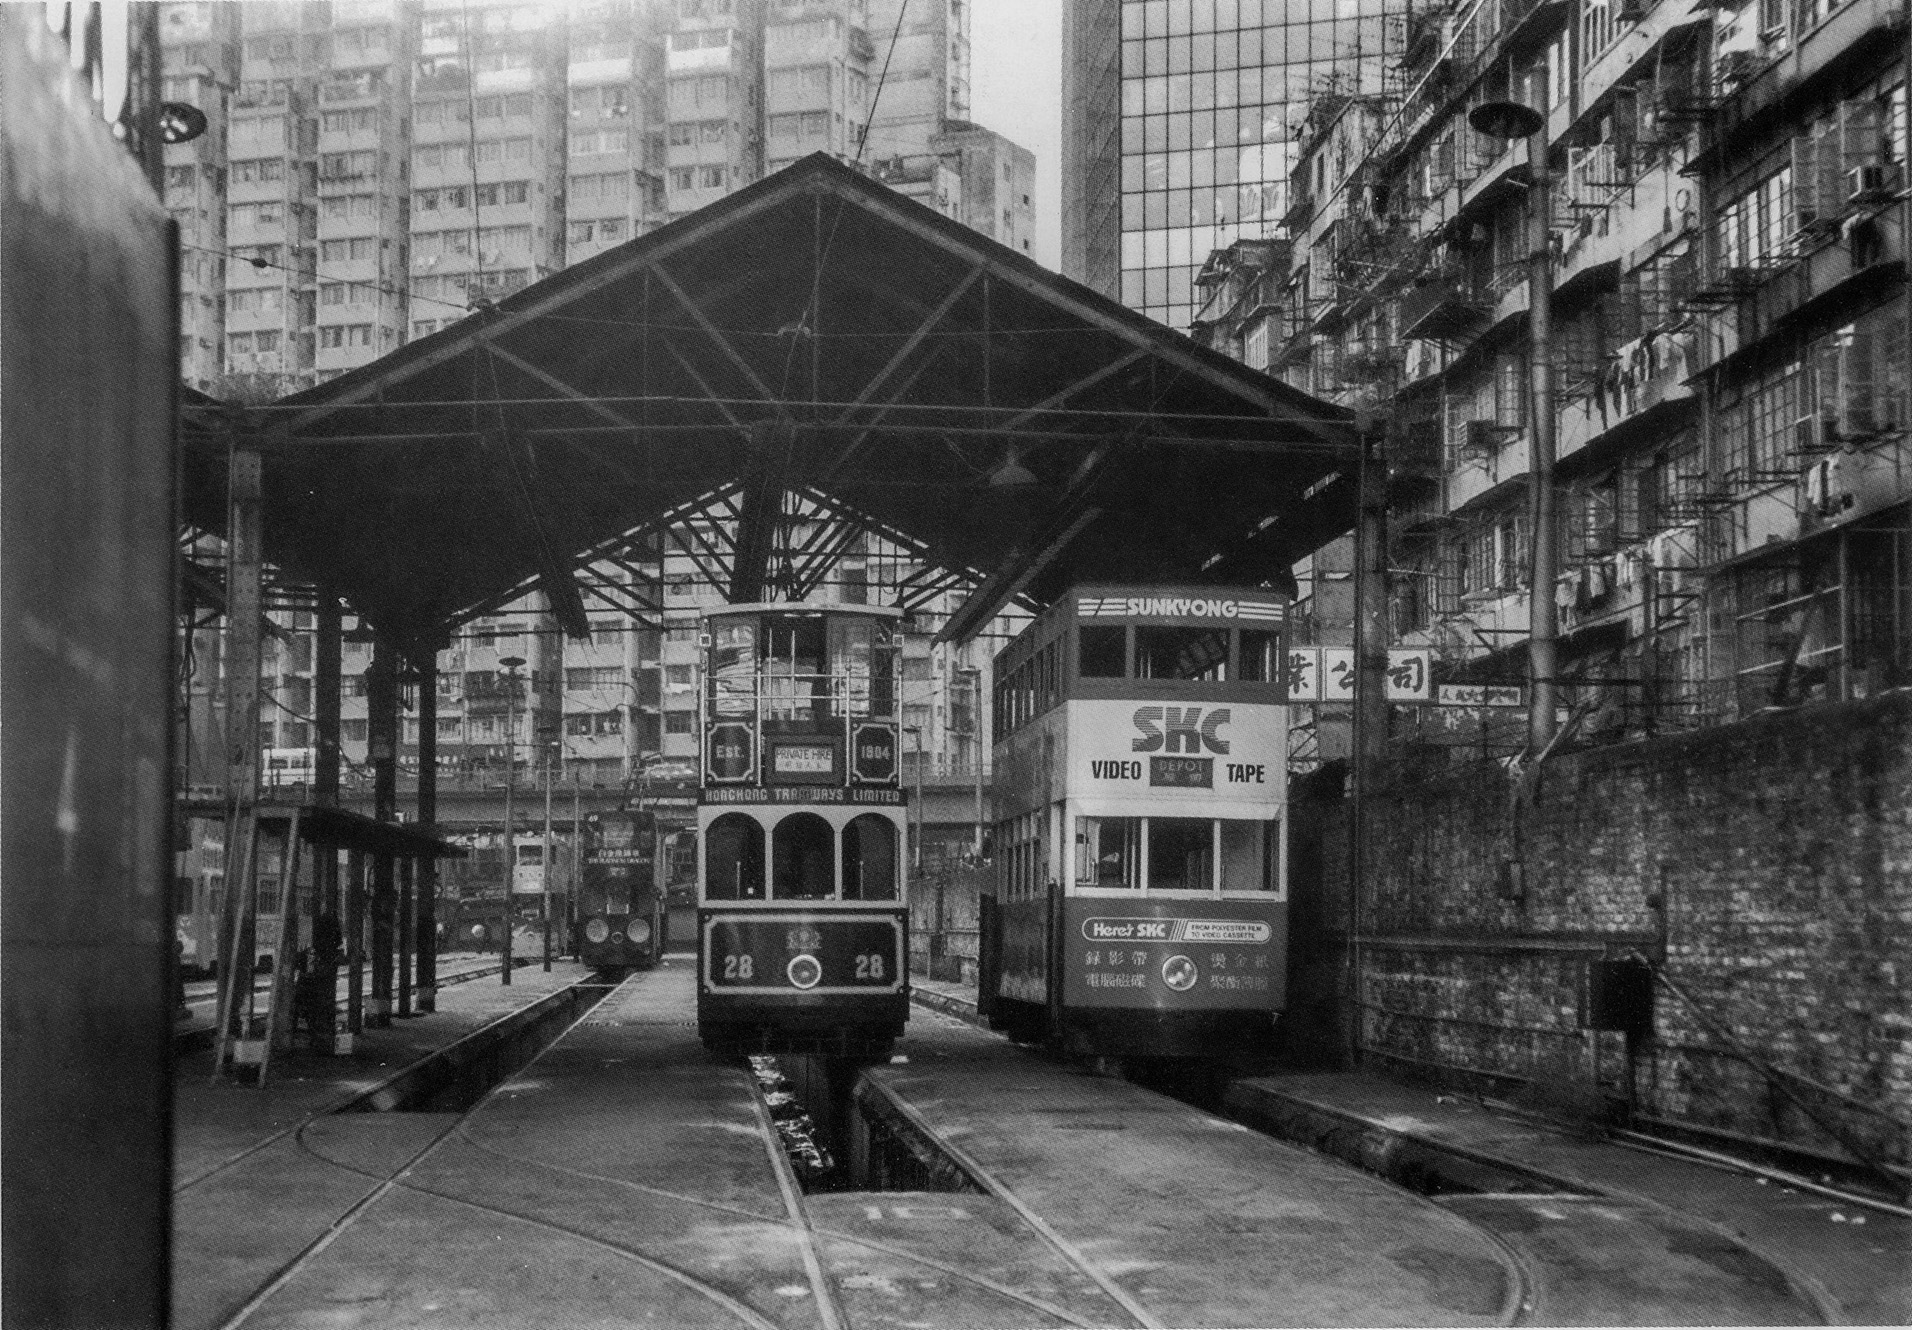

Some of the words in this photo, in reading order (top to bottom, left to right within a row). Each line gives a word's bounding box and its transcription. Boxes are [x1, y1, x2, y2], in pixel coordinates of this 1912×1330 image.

[1126, 598, 1238, 618] SUNKYONG
[1132, 706, 1231, 755] SKC
[716, 745, 745, 758] Est.
[776, 748, 809, 760] PRIVATE
[812, 748, 832, 760] HIRE
[1091, 760, 1142, 780] VIDEO
[1159, 760, 1204, 772] DEPOT
[1226, 764, 1265, 783] TAPE
[705, 788, 768, 801] HONGKONG
[774, 788, 844, 801] TRAMWAYS
[852, 788, 900, 802] LIMITED
[1137, 923, 1166, 937] SKC
[724, 954, 754, 979] 28
[855, 954, 885, 980] 28
